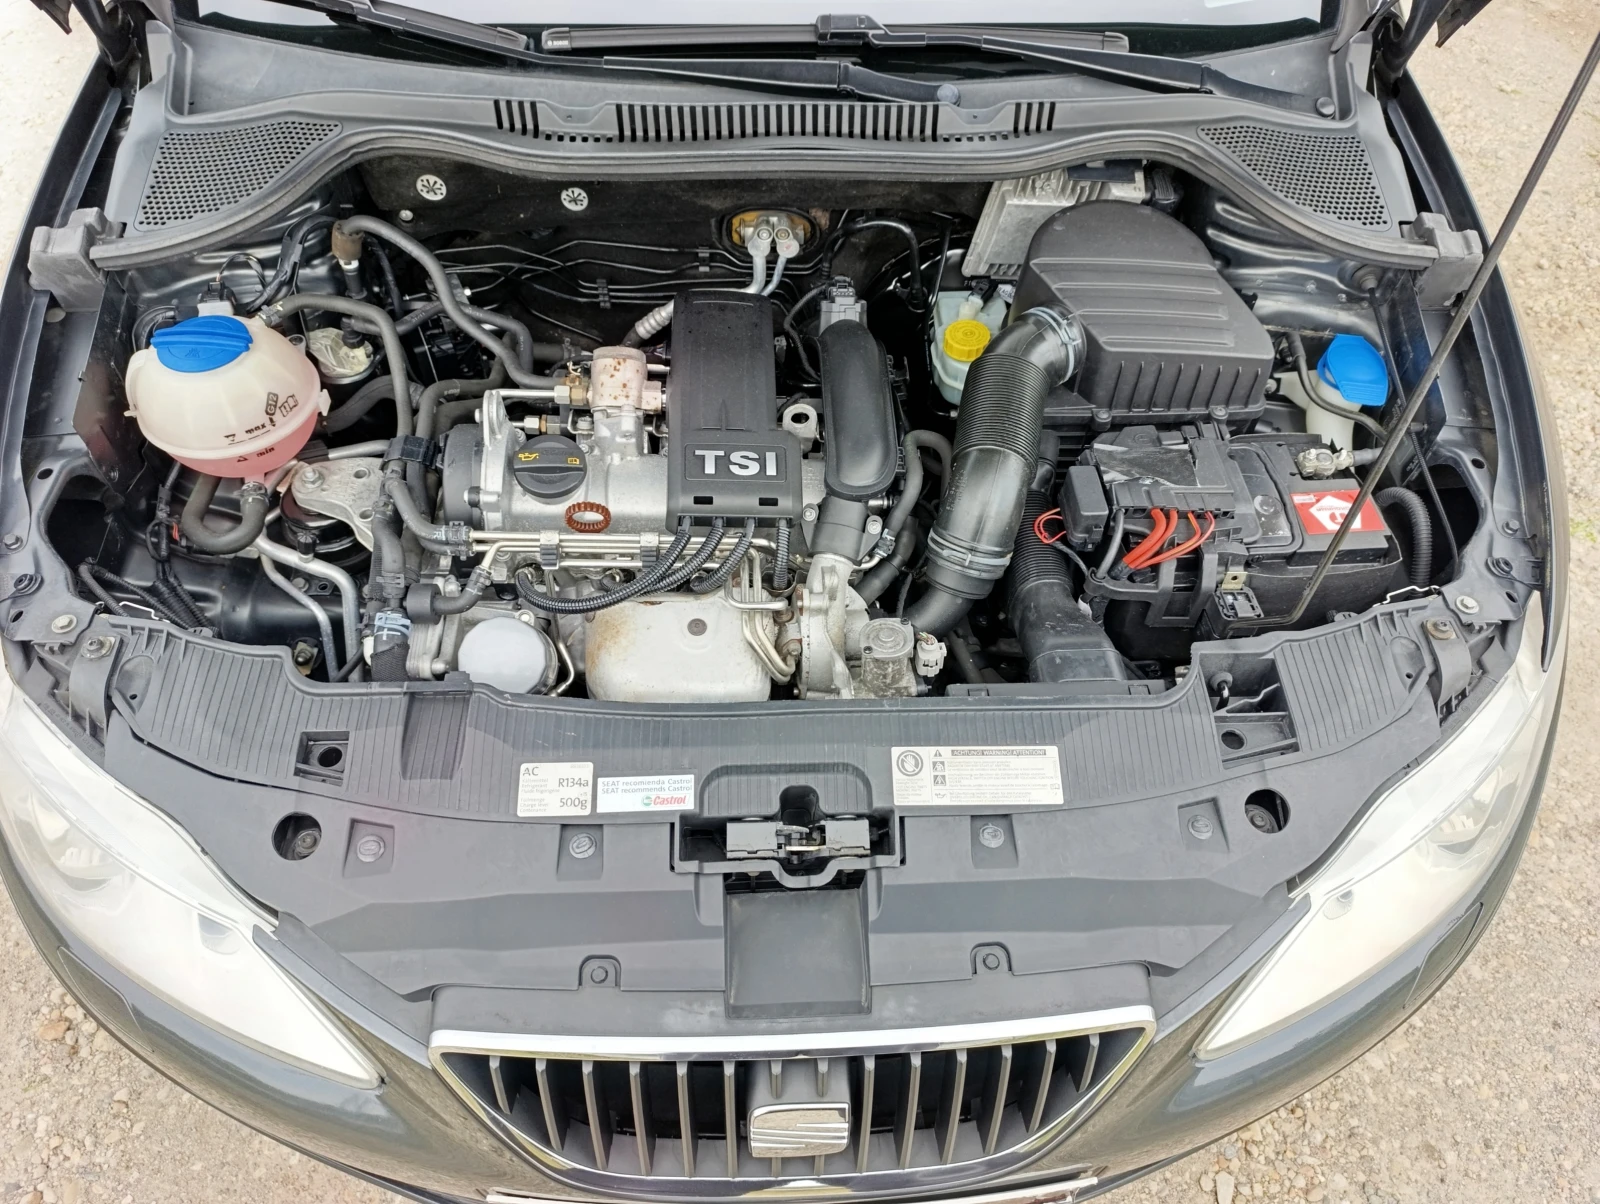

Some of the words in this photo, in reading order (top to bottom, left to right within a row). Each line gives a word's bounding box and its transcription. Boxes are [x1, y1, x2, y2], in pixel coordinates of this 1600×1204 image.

[267, 393, 278, 413] G12
[245, 422, 267, 435] max
[256, 446, 275, 458] min
[694, 449, 778, 476] TSI
[522, 766, 540, 777] AC
[557, 777, 589, 788] R134a
[622, 778, 665, 786] recomienda
[621, 785, 667, 793] recommends
[558, 796, 588, 810] 500g
[653, 794, 687, 806] Castrol
